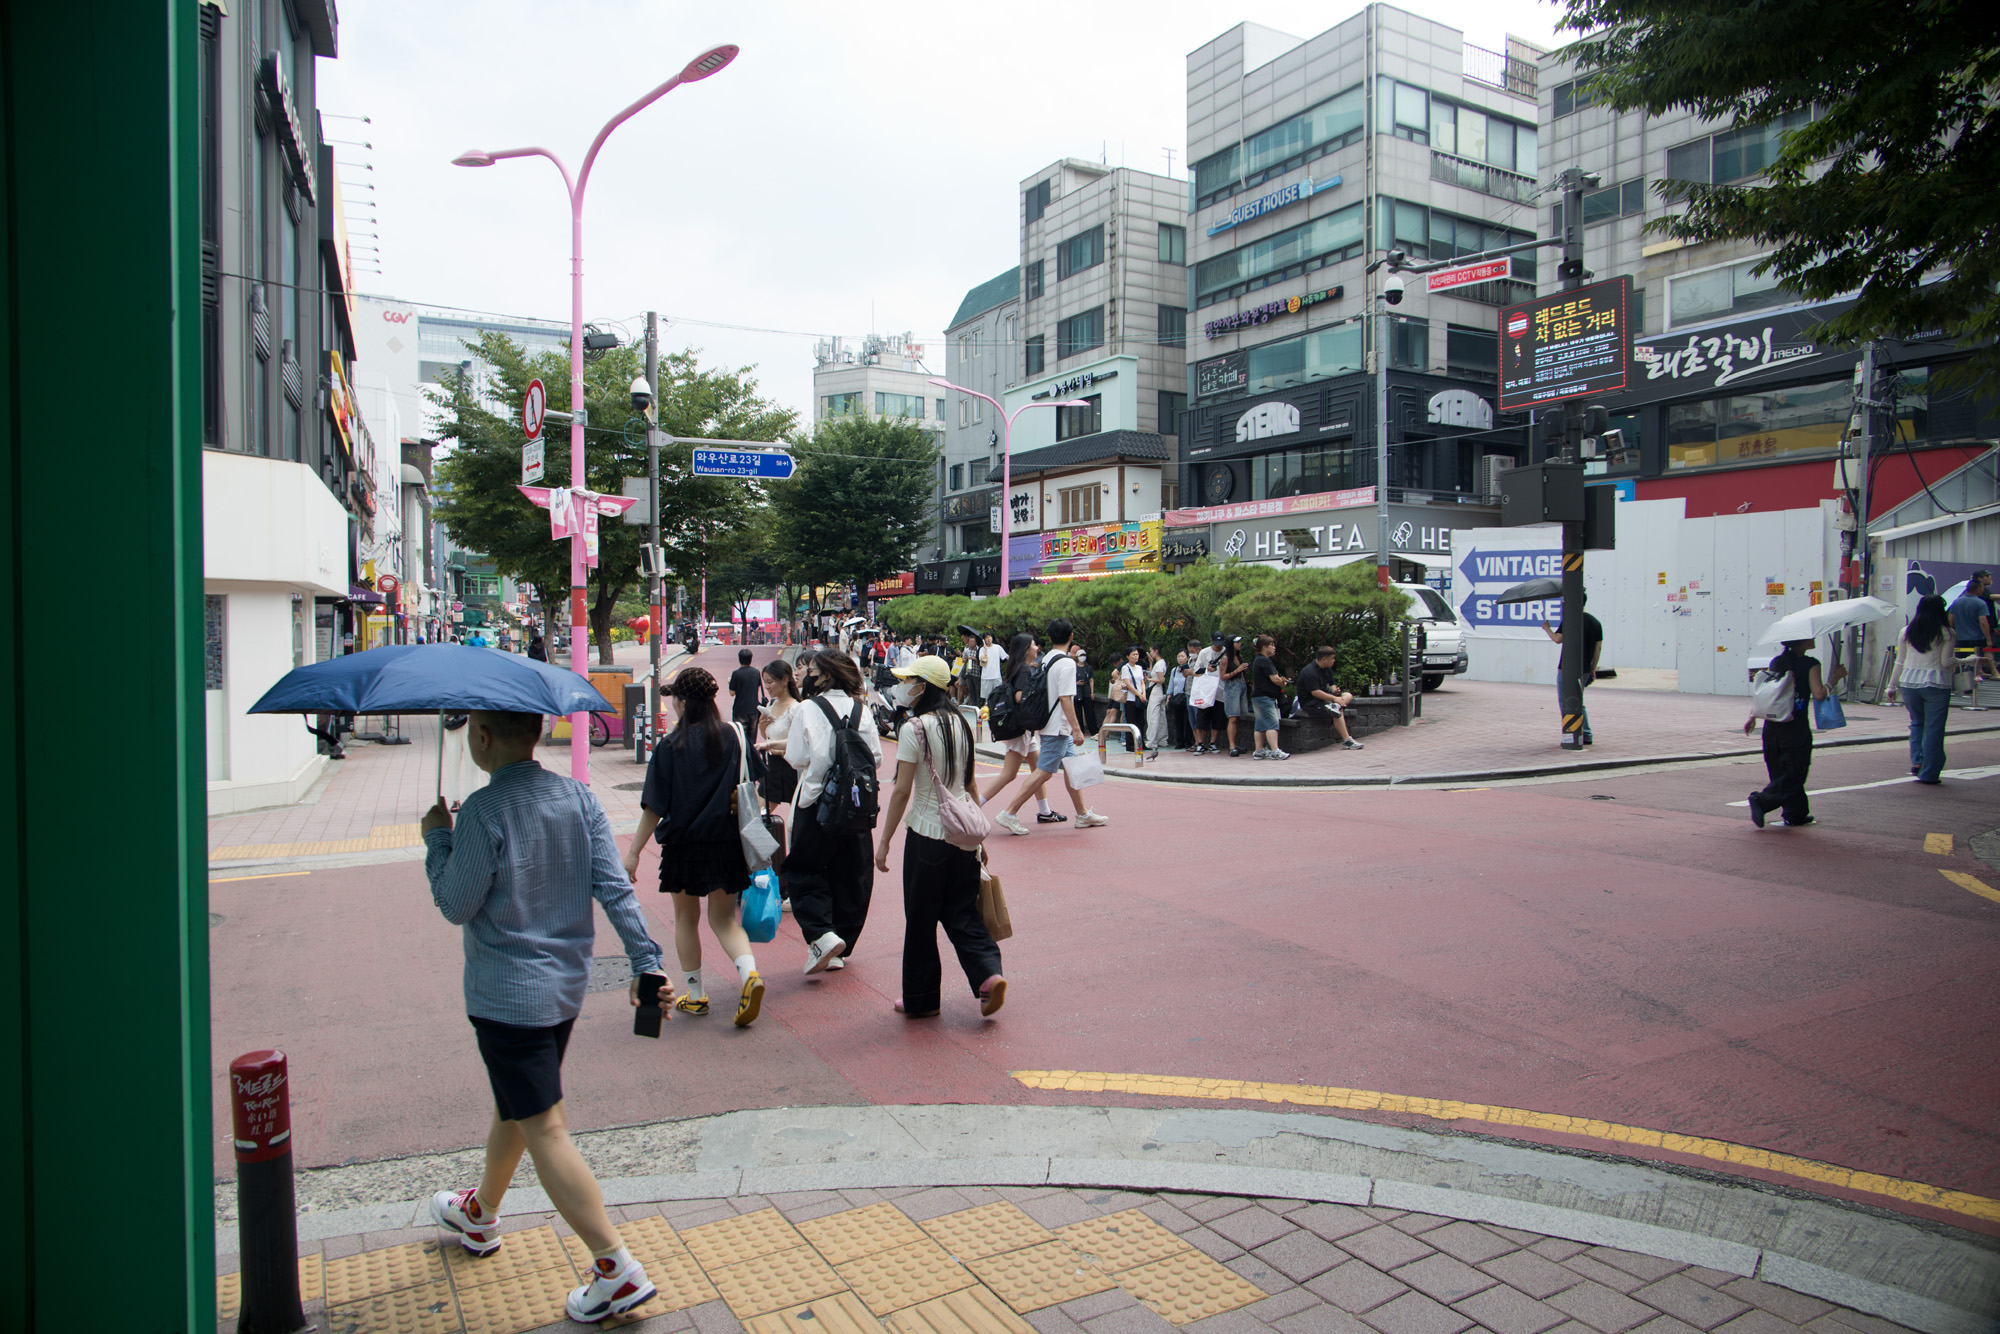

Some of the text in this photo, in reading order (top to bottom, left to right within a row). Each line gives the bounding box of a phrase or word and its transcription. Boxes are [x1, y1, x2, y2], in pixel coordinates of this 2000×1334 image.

[1231, 201, 1262, 225] GUEST
[1263, 184, 1298, 212] HOUSE
[1457, 269, 1477, 282] CCTV
[383, 310, 409, 324] CGV
[1535, 298, 1592, 326] 레드로드
[1535, 325, 1550, 343] 차
[1553, 320, 1582, 340] 없는
[1586, 308, 1616, 331] 거리
[1645, 327, 1774, 387] 태초갈비
[1772, 345, 1813, 360] TAECHO
[696, 452, 761, 466] 와우산로23길
[696, 465, 758, 476] Wausan-ro 23-gil
[1226, 508, 1233, 518] &
[1234, 503, 1258, 517] 파스타
[1259, 501, 1284, 514] 전문점
[1161, 539, 1206, 558] 하회마을
[1255, 523, 1365, 556] HETEA
[1476, 555, 1563, 577] VINTAGE
[1476, 599, 1562, 621] STORE
[232, 1073, 287, 1097] 레드로드
